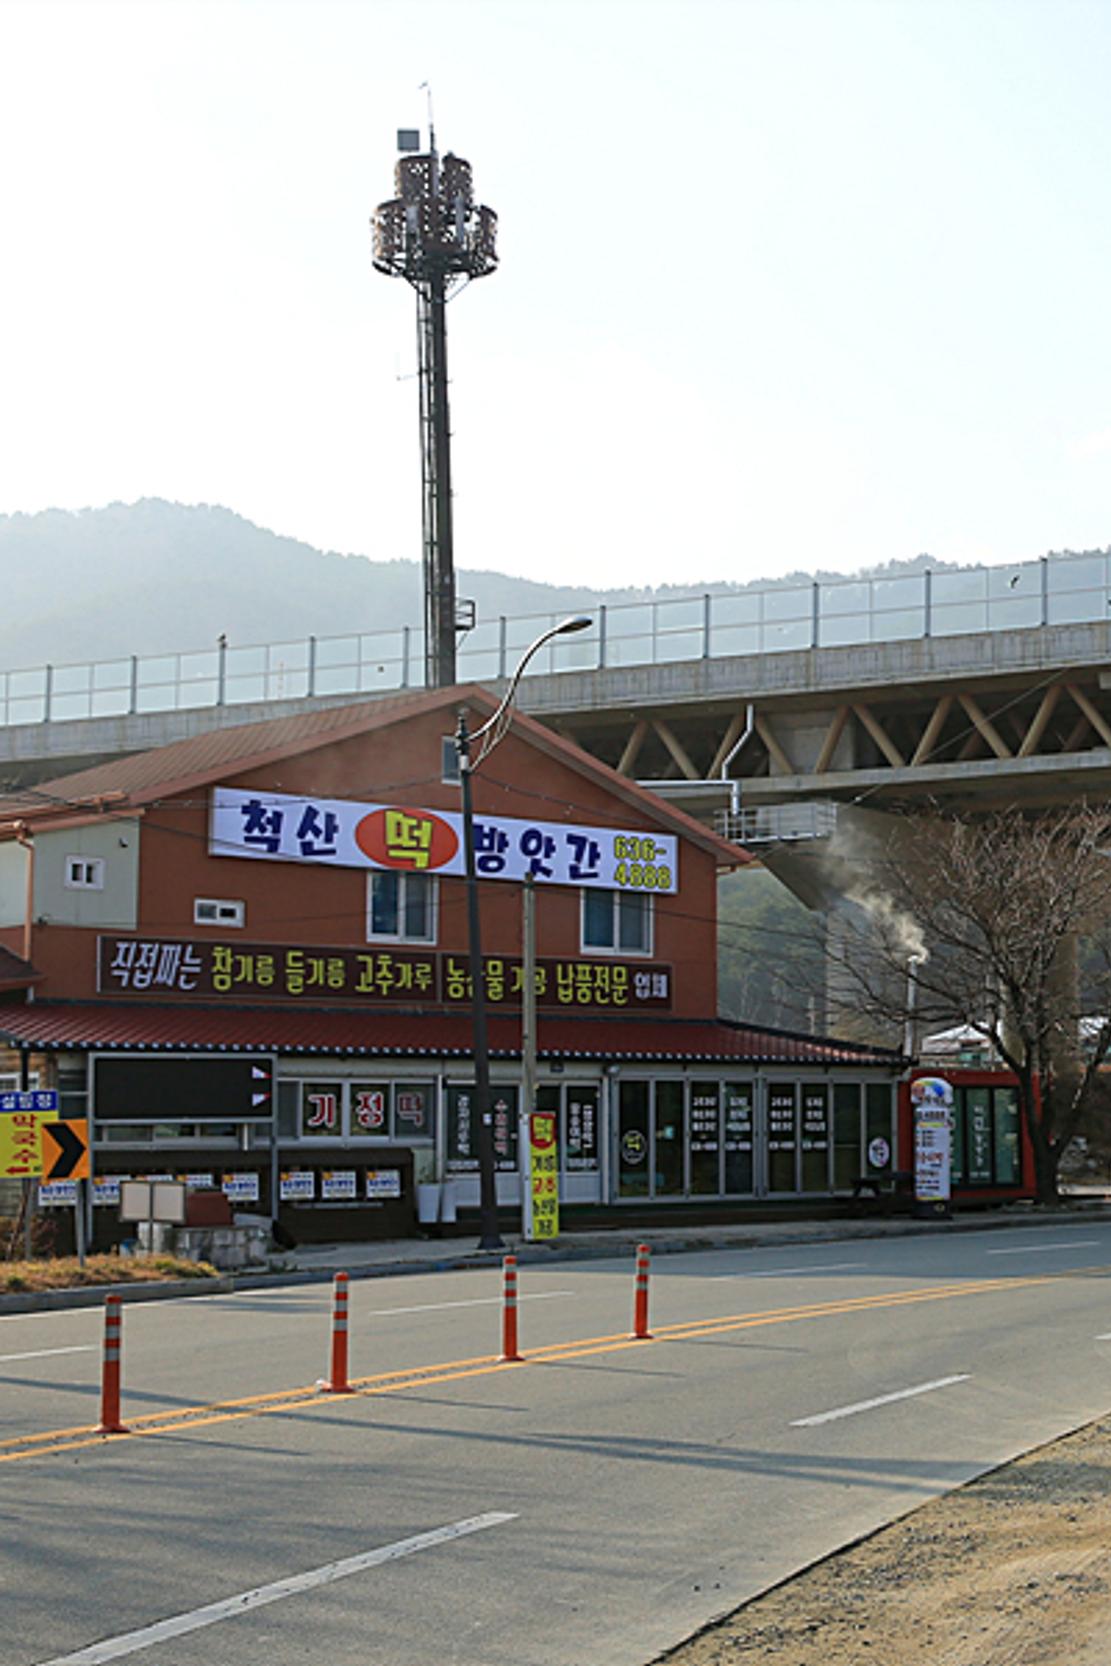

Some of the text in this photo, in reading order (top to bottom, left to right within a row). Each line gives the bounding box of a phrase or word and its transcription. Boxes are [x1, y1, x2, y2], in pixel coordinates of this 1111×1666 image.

[241, 800, 600, 880] 척산 떡 방앗간
[613, 863, 671, 889] 4888
[212, 947, 274, 991] 참기름
[286, 951, 345, 994] 들기름
[354, 954, 432, 996] 고추가루
